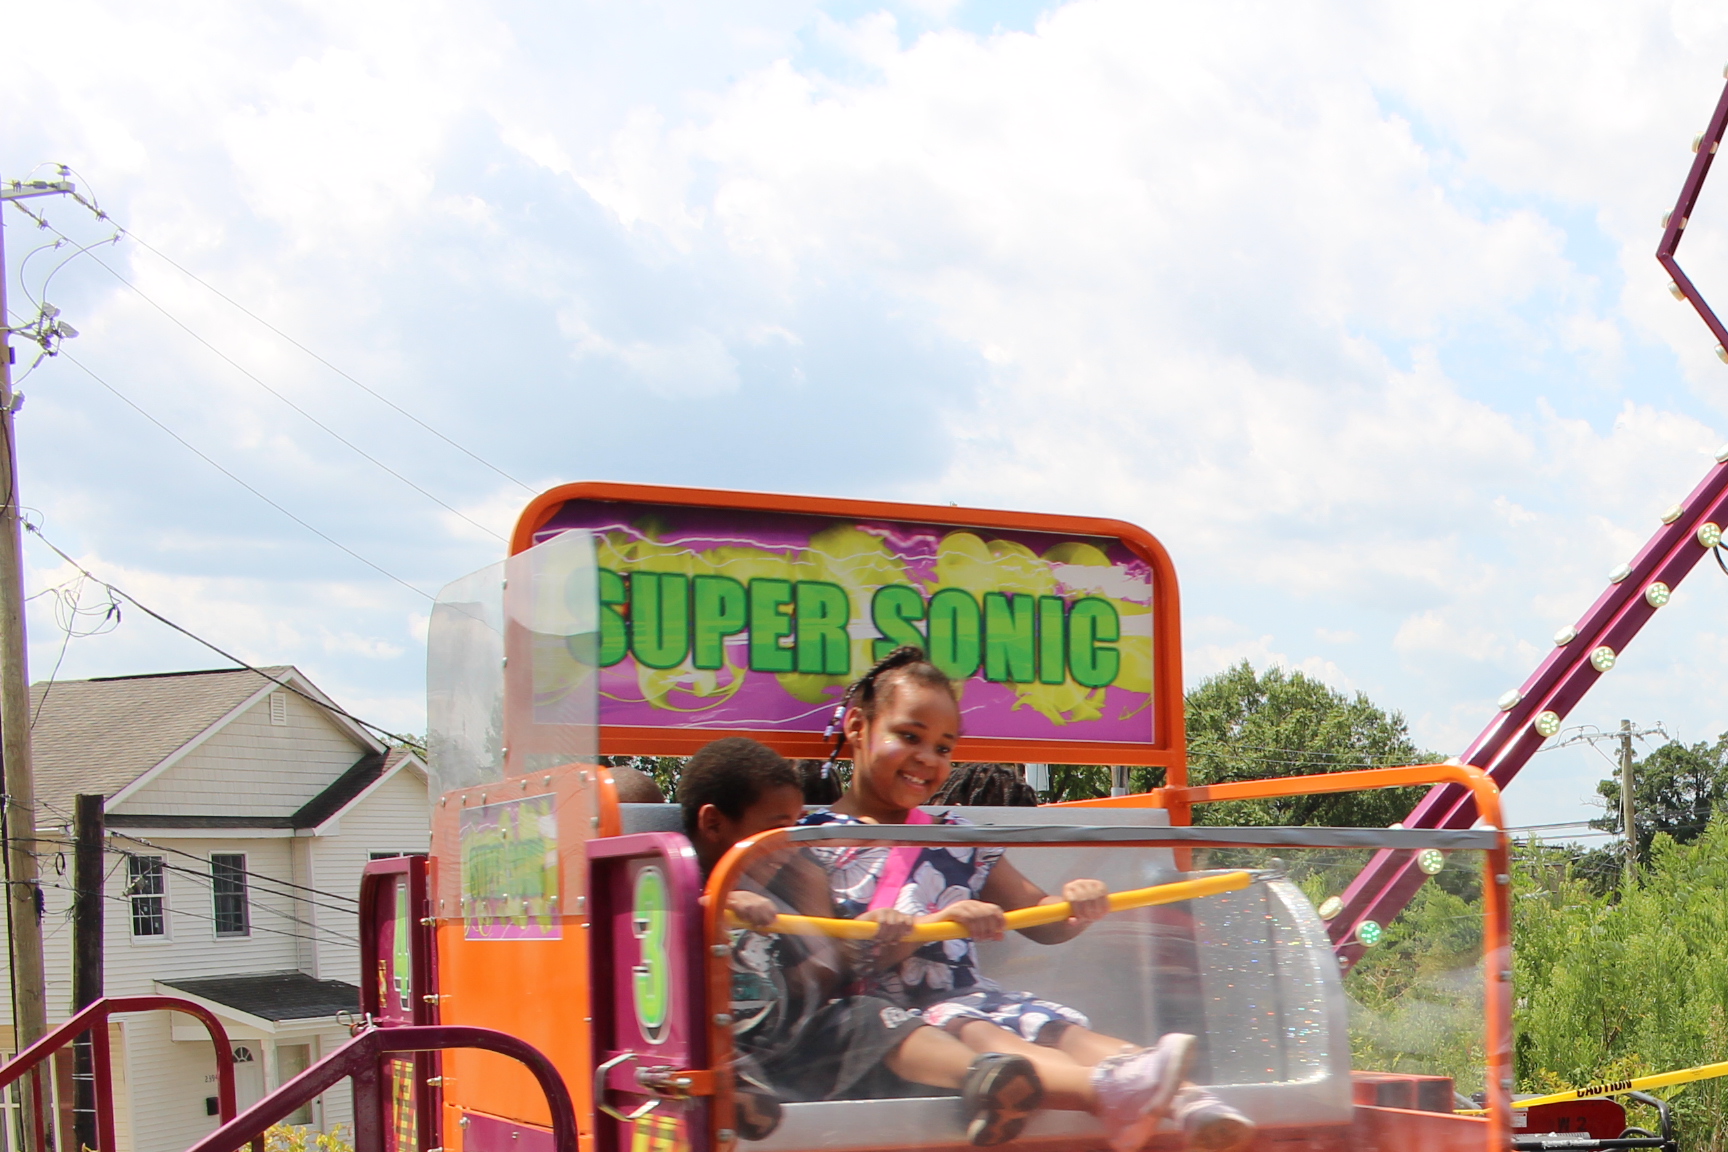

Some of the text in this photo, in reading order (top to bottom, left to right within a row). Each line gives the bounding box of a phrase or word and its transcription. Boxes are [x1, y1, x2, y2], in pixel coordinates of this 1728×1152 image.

[565, 566, 1121, 689] SUPER SONIC
[633, 865, 672, 1045] 3
